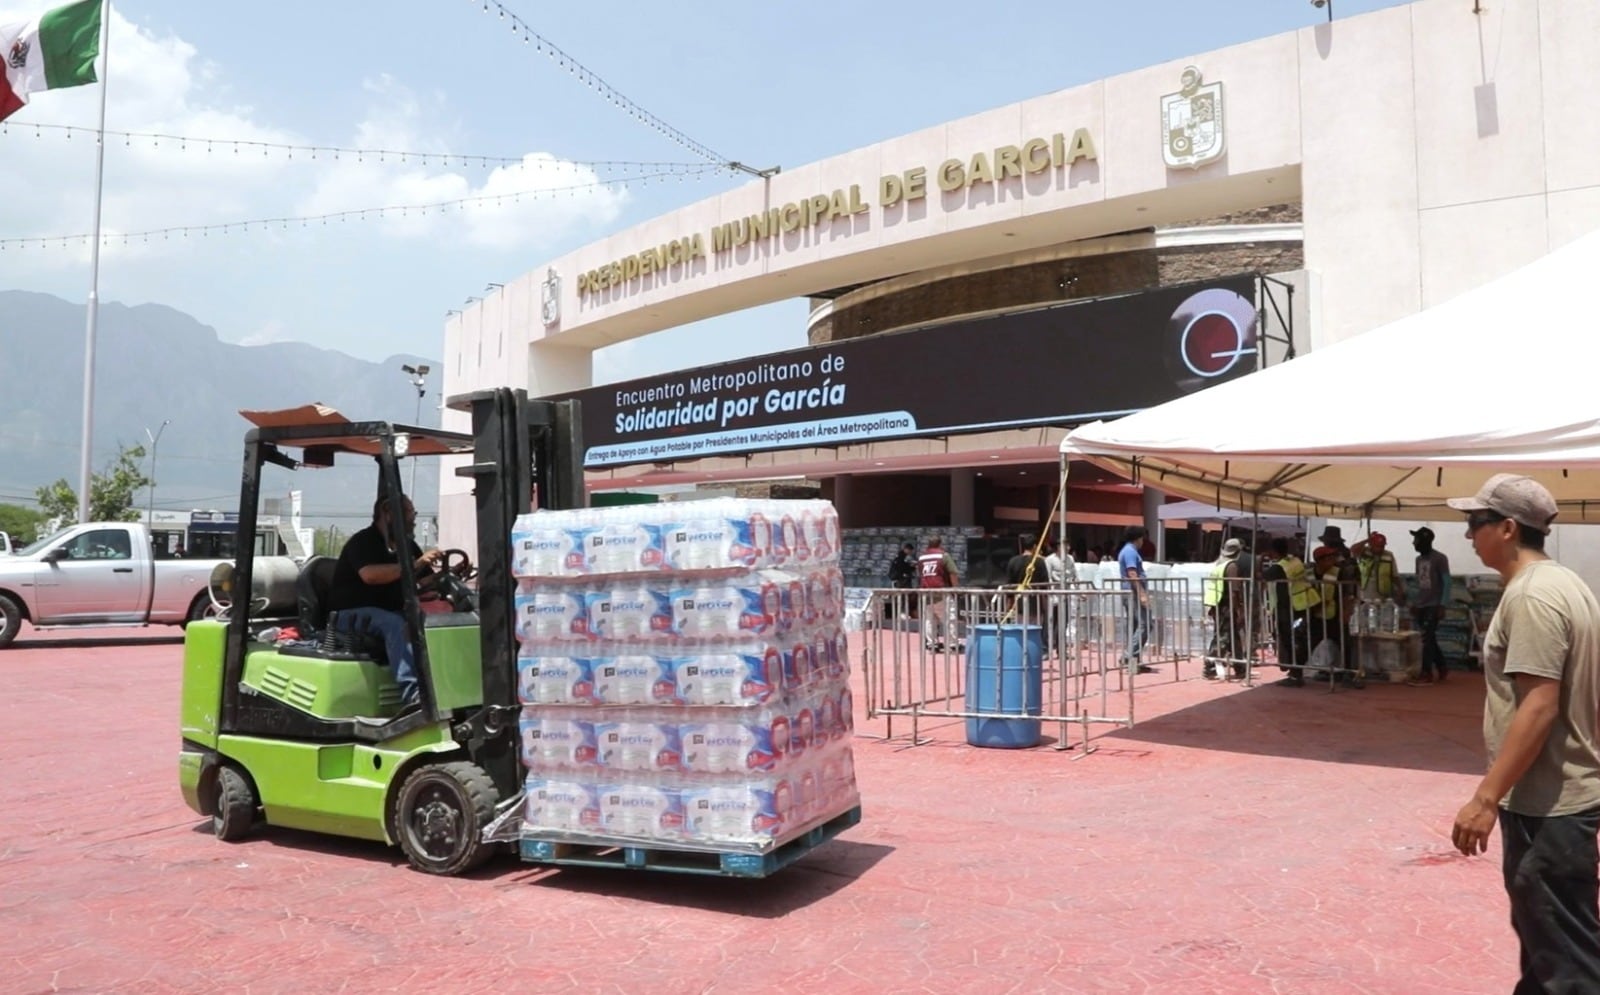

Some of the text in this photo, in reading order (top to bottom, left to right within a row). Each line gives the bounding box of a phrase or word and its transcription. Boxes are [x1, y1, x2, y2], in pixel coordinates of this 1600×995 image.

[577, 233, 705, 295] PRESIDENCIA
[711, 184, 869, 253] MUNICIPAL
[880, 166, 926, 207] DE
[937, 127, 1097, 191] GARCIA
[615, 353, 845, 407] Encuentro Metropolitano de
[615, 378, 846, 434] Solidaridad por García
[637, 446, 649, 455] con
[650, 444, 666, 456] Agua
[667, 440, 692, 452] Potable
[693, 440, 704, 452] por
[705, 434, 748, 448] Presidentes
[750, 427, 800, 443] Municipales
[802, 426, 816, 439] del
[817, 423, 839, 437] Área
[840, 417, 909, 434] Metropolitana
